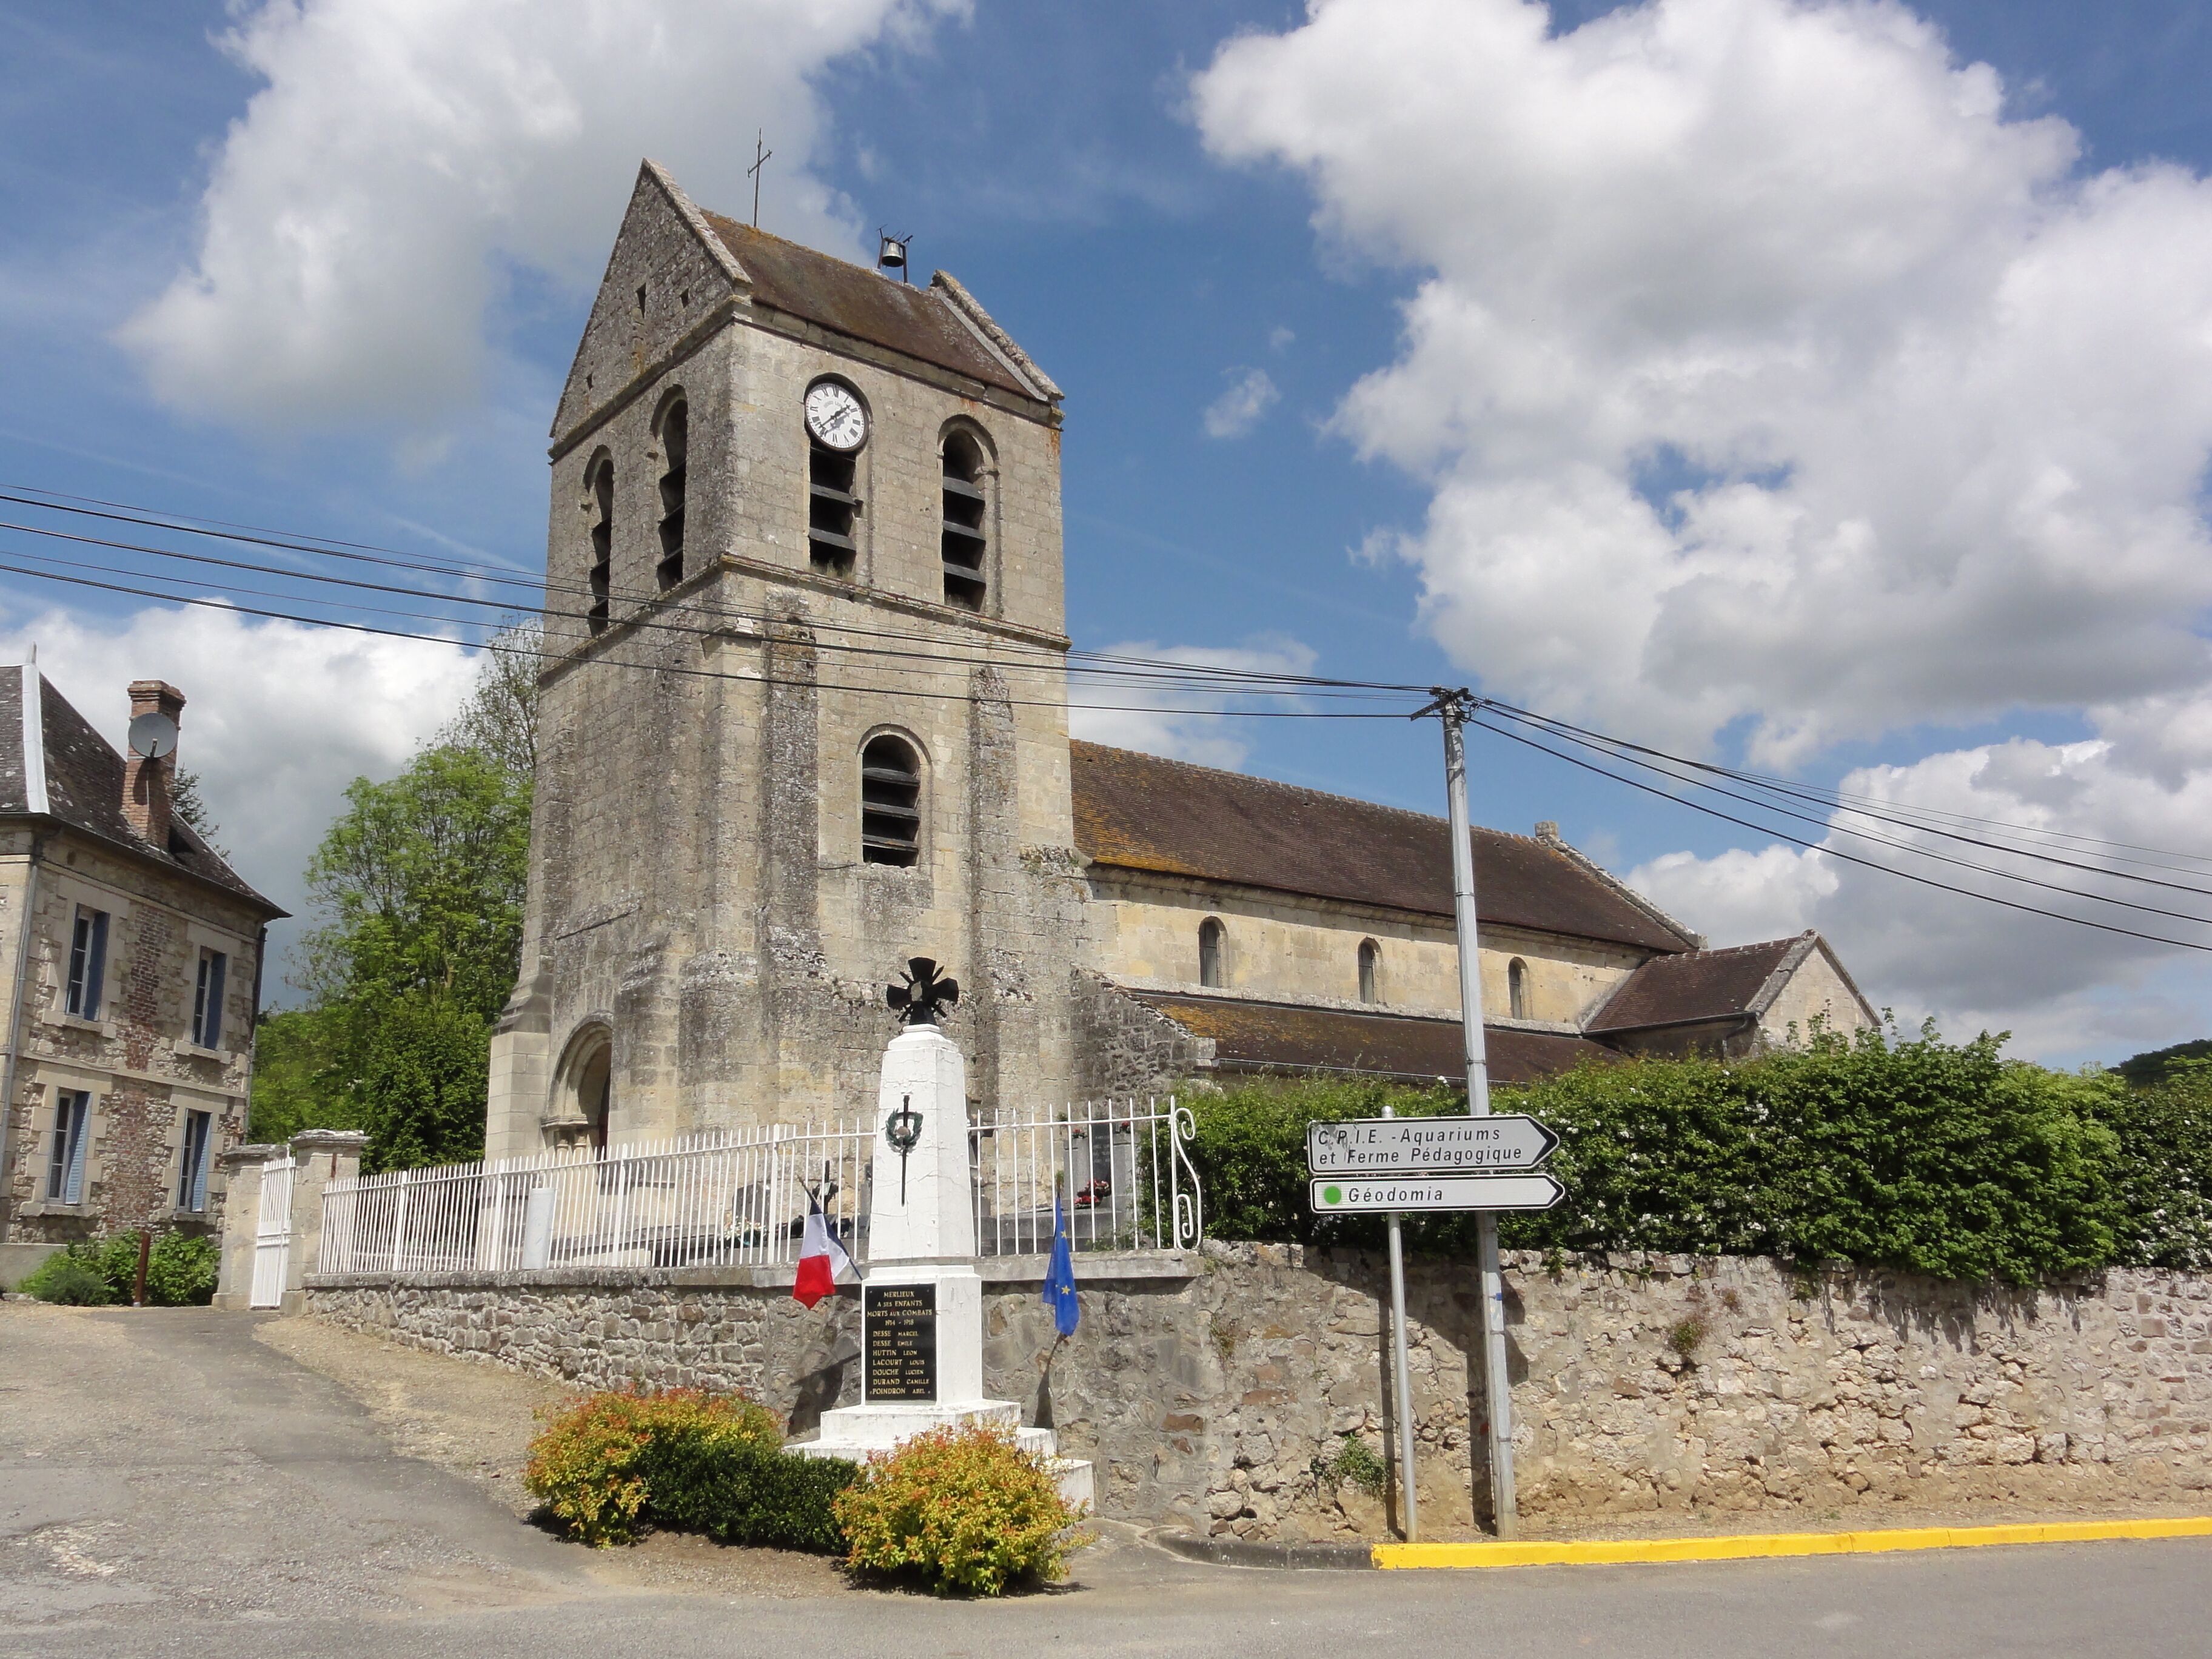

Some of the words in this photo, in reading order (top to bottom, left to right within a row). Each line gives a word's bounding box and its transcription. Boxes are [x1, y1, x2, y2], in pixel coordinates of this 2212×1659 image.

[1318, 1129, 1382, 1145] C.P.I.E.
[1319, 1151, 1336, 1164] et
[1347, 1150, 1399, 1164] Ferme
[1410, 1147, 1522, 1165] Pédagogique
[1349, 1187, 1443, 1202] Géodomia
